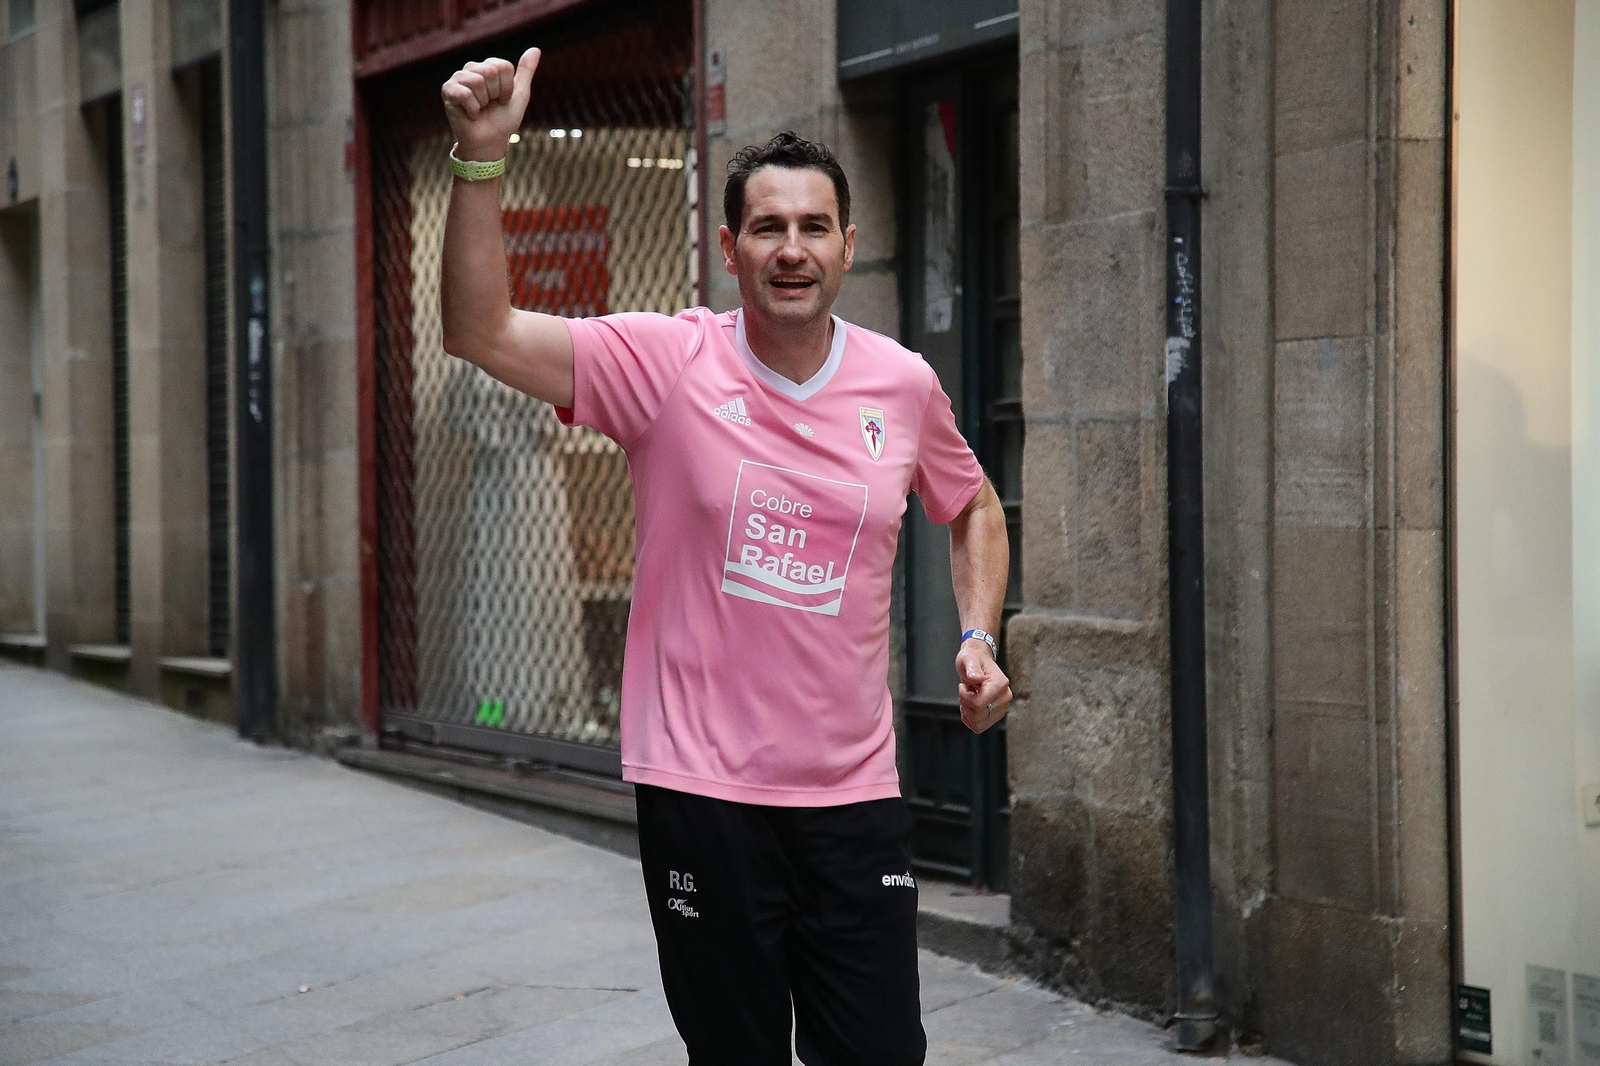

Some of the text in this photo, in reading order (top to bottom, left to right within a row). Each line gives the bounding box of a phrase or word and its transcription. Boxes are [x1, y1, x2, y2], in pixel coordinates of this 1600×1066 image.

[713, 407, 752, 427] adidas
[750, 489, 814, 518] Cobre
[744, 513, 807, 549] San
[739, 544, 835, 584] Rafael
[669, 870, 697, 893] R.G.
